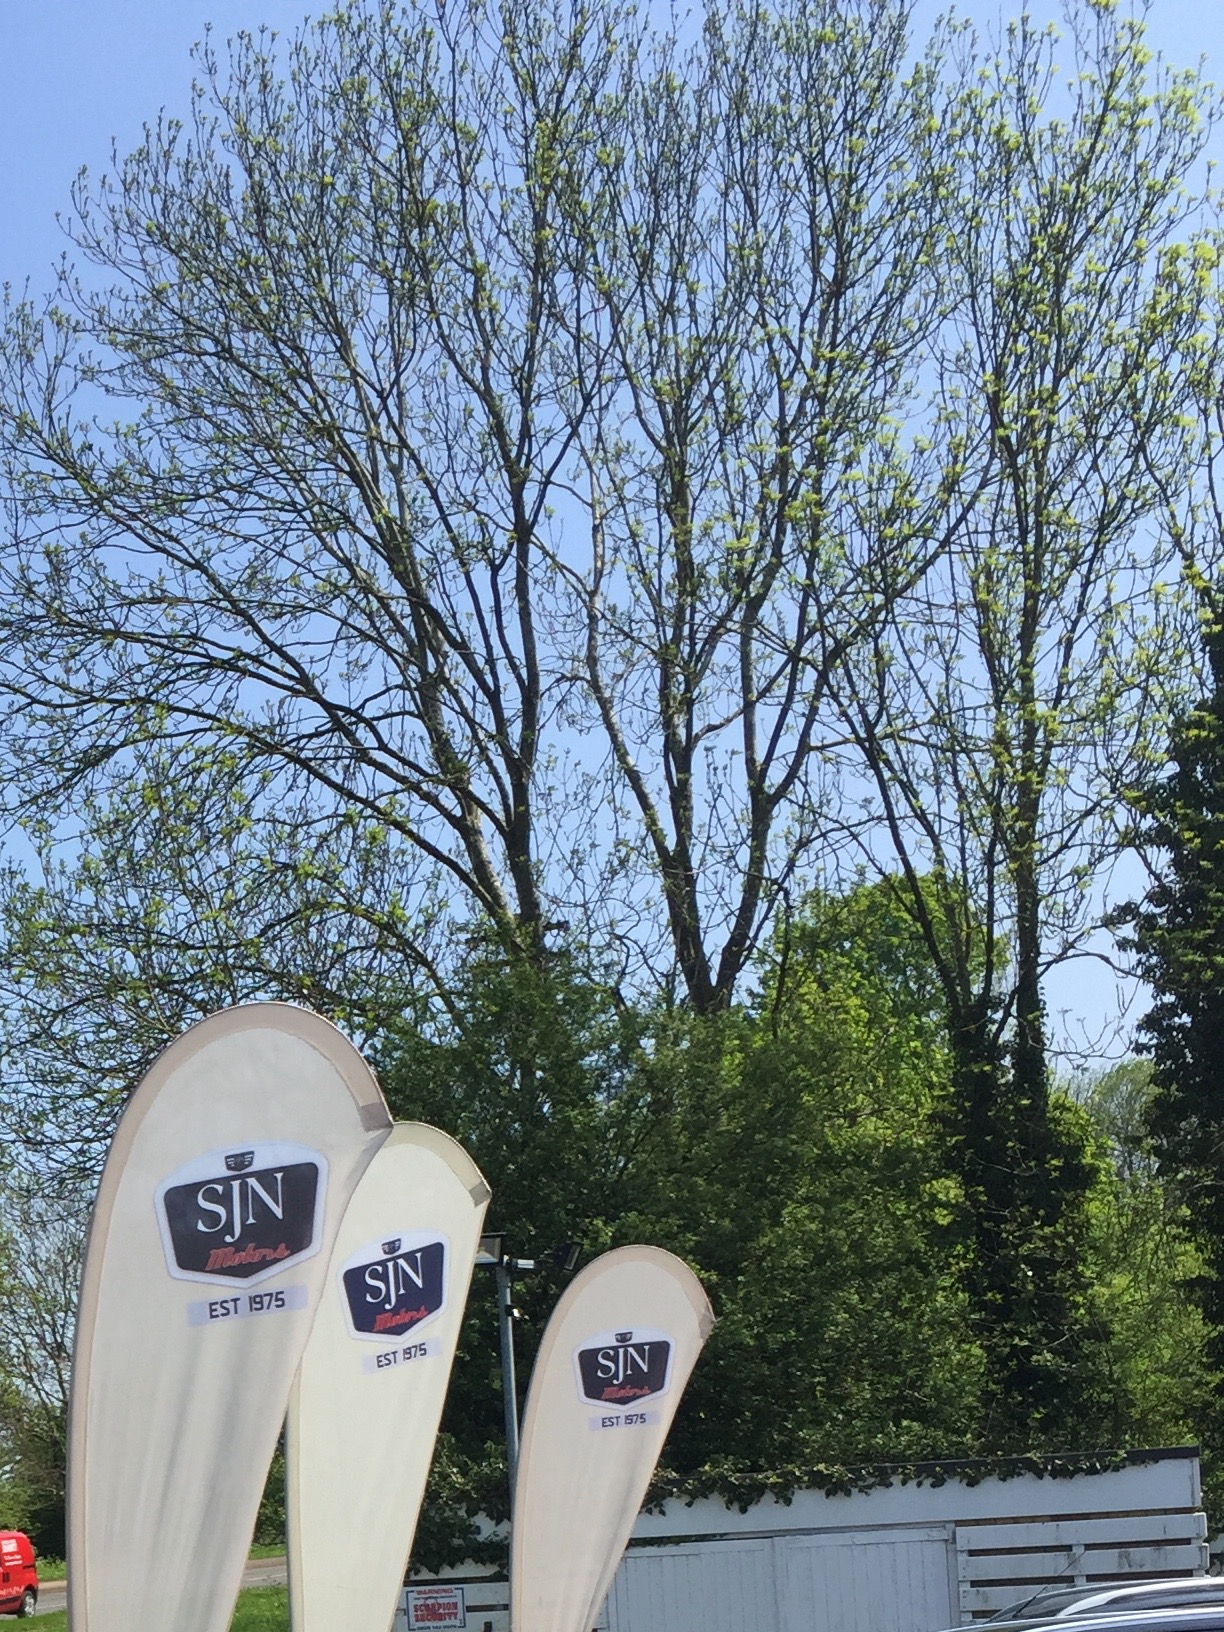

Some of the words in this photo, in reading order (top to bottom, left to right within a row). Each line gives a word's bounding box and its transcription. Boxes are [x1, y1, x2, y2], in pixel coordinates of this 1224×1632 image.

[196, 1172, 284, 1243] SJN
[205, 1243, 290, 1270] Motors
[364, 1252, 425, 1310] SJN
[209, 1297, 240, 1319] EST
[249, 1291, 285, 1313] 1975
[376, 1350, 398, 1369] EST
[403, 1343, 427, 1362] 1975
[596, 1345, 650, 1385] SJN
[601, 1416, 621, 1428] EST
